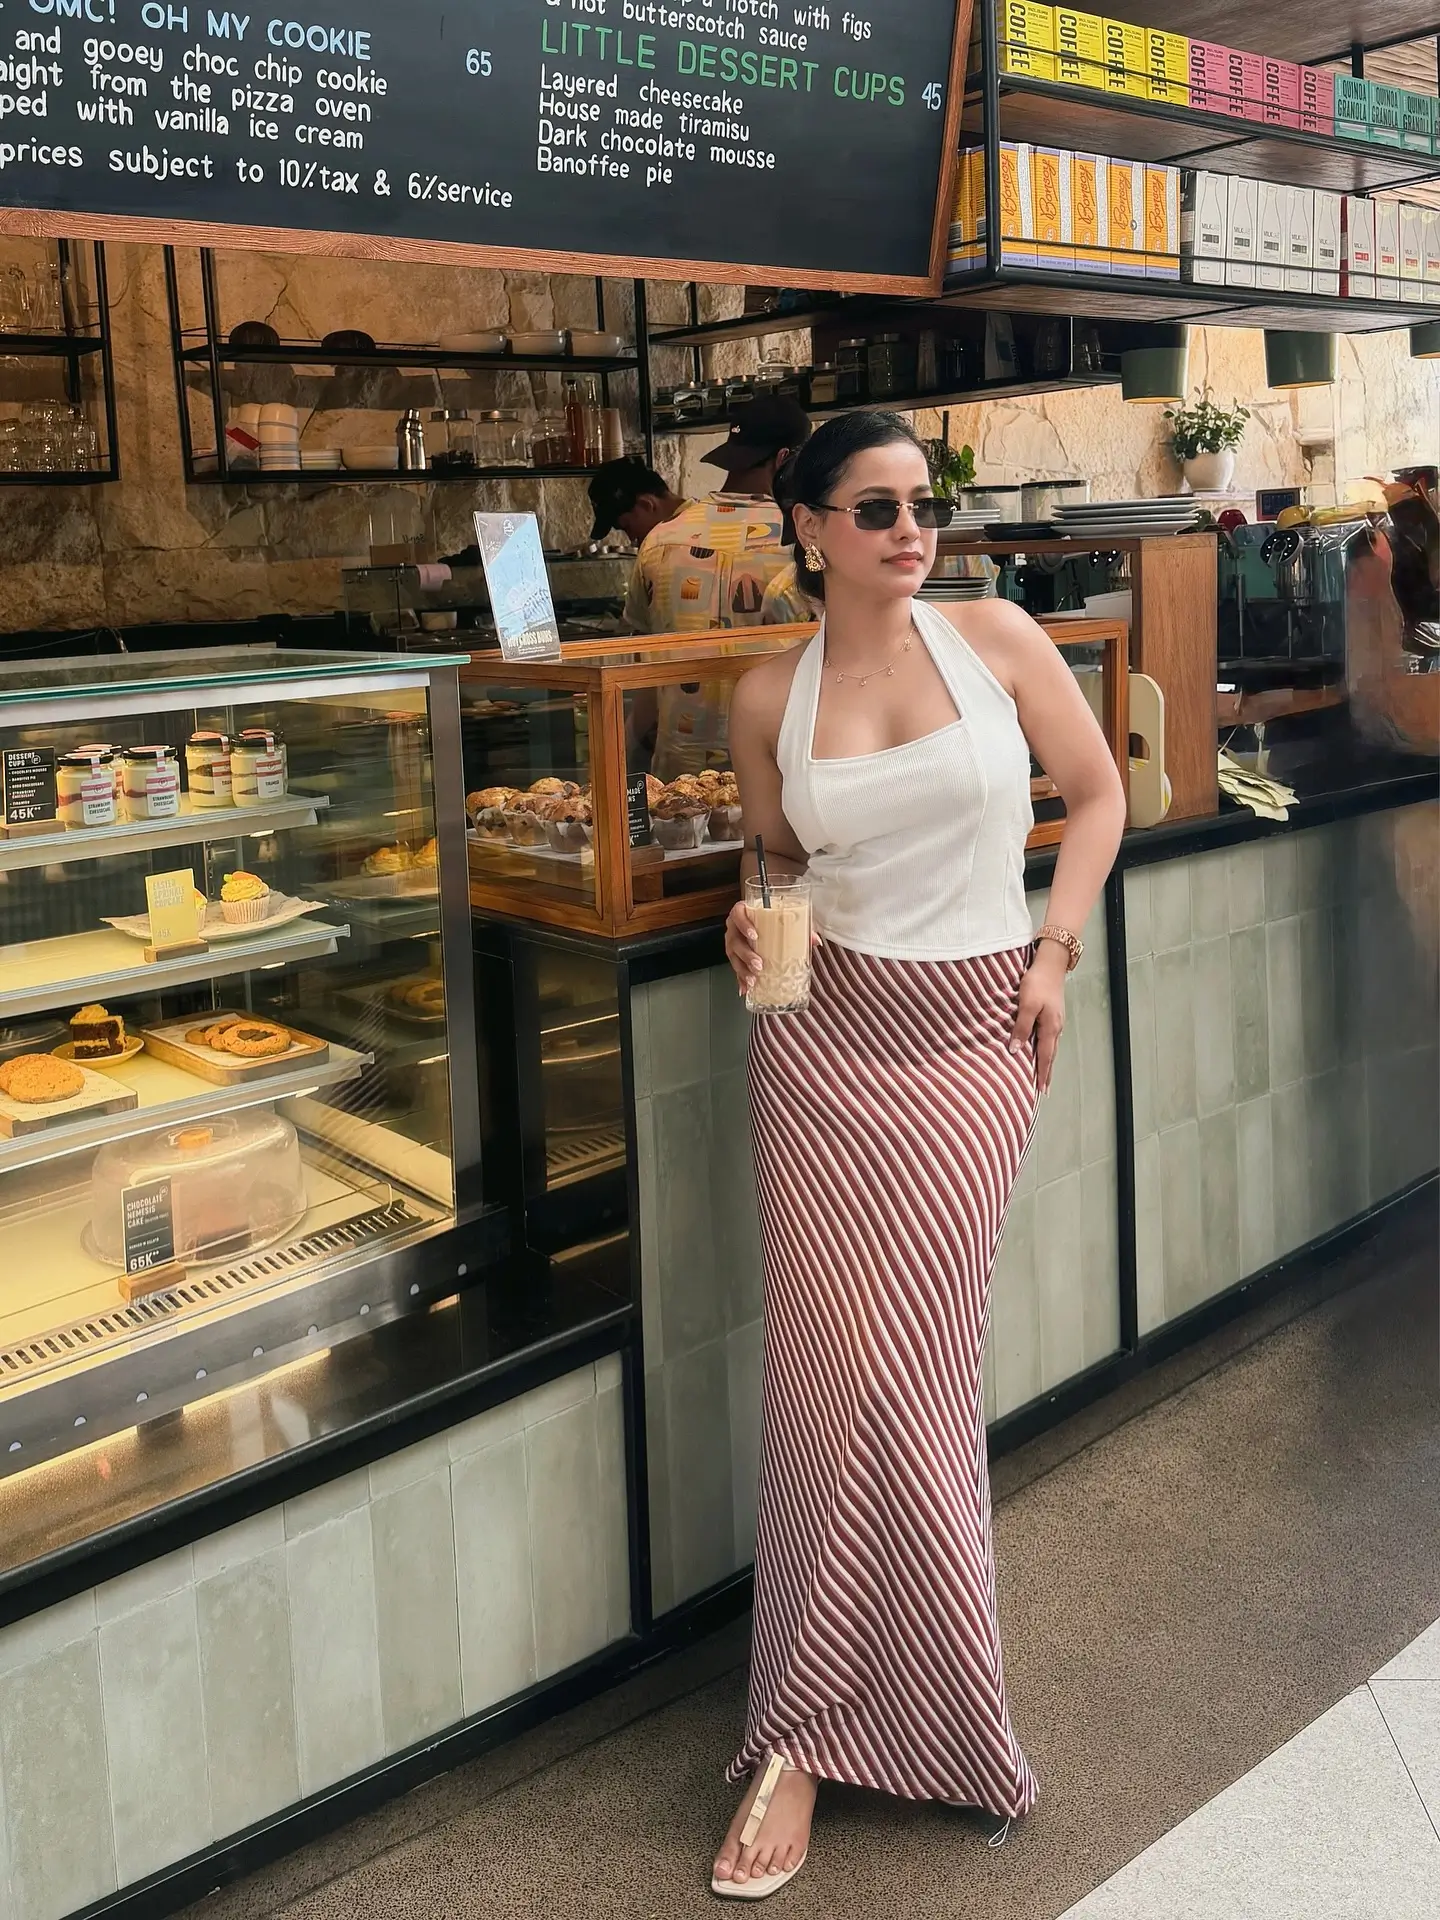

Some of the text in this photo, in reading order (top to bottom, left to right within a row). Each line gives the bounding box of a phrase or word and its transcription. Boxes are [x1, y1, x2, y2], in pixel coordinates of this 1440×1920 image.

[142, 3, 187, 33] OH
[208, 10, 250, 41] MY
[268, 19, 371, 60] COOKIE
[623, 0, 745, 40] butterscotch
[759, 27, 807, 51] sauce
[794, 5, 829, 30] with
[842, 12, 871, 41] figs
[16, 26, 387, 95] and gooey choc chip cookie
[466, 49, 492, 76] 65
[543, 19, 941, 110] LITTLE DESSERT CUPS 45
[1107, 25, 1125, 88] COFFEE
[90, 64, 147, 96] from
[170, 74, 211, 103] the
[232, 84, 293, 112] pizza
[316, 98, 370, 122] oven
[541, 63, 742, 115] Layered cheesecake
[1338, 99, 1366, 121] GRANOLA
[1343, 80, 1366, 101] QUINOA
[1376, 87, 1398, 108] QUINOA
[77, 96, 133, 125] with
[155, 107, 228, 135] vanilla
[250, 113, 278, 139] ice
[295, 125, 363, 149] cream
[540, 92, 749, 141] House made tiramisu
[1372, 105, 1398, 127] GRANOLA
[0, 137, 83, 169] prices
[109, 145, 213, 180] subject
[236, 158, 263, 182] to
[374, 169, 390, 196] &
[538, 146, 672, 187] Banoffee pie
[539, 119, 775, 169] Dark chocolate mousse
[1000, 153, 1018, 216] Bonsoy
[1039, 159, 1058, 220] Bonsoy
[1077, 164, 1096, 225] Bonsoy
[1113, 171, 1131, 230] Bonsoy
[1149, 175, 1165, 232] Bonsoy
[8, 752, 35, 761] DESSERT
[126, 1194, 162, 1211] CHOCOLATE
[127, 1204, 156, 1221] NEMESIS
[127, 1216, 144, 1228] CAKE
